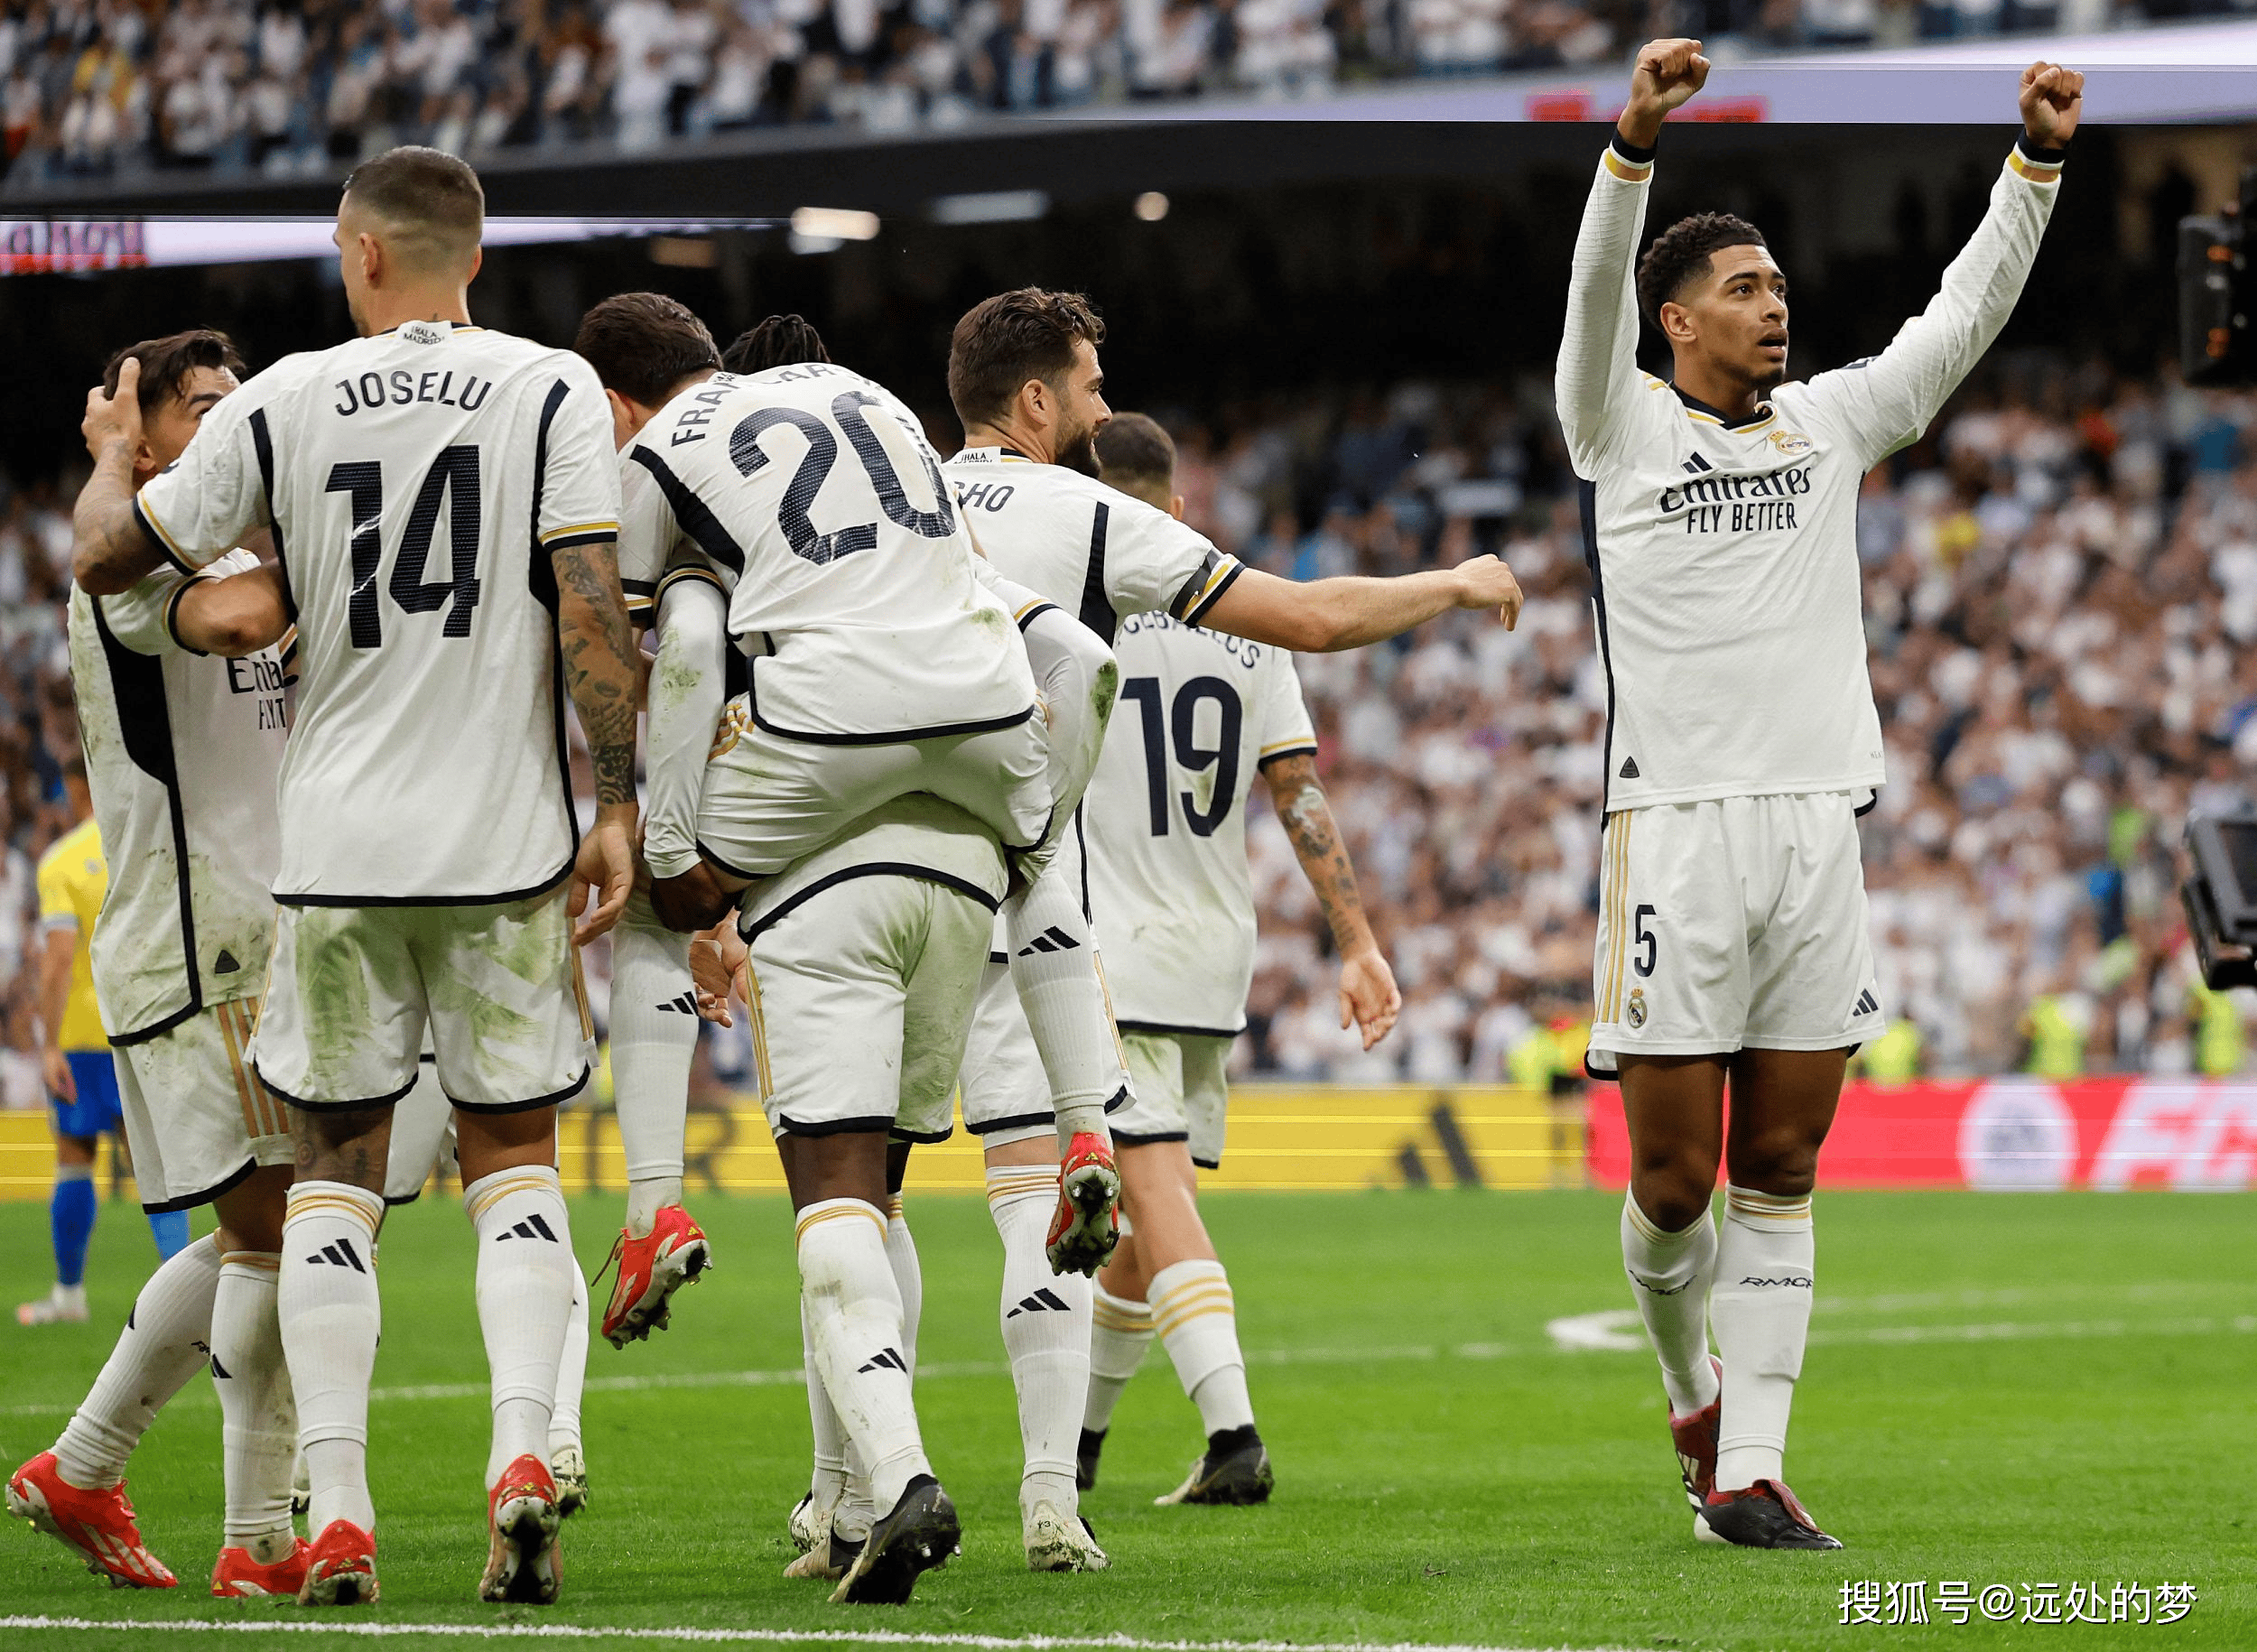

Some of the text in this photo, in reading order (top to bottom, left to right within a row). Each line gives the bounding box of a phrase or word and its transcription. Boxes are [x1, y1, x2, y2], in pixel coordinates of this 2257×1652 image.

[335, 370, 492, 416] JOSELU
[729, 391, 956, 566] 20
[1660, 466, 1811, 514] Emirates
[325, 444, 481, 648] 14
[1687, 502, 1798, 534] FLY BETTER
[1119, 675, 1242, 837] 19
[1634, 905, 1657, 978] 5
